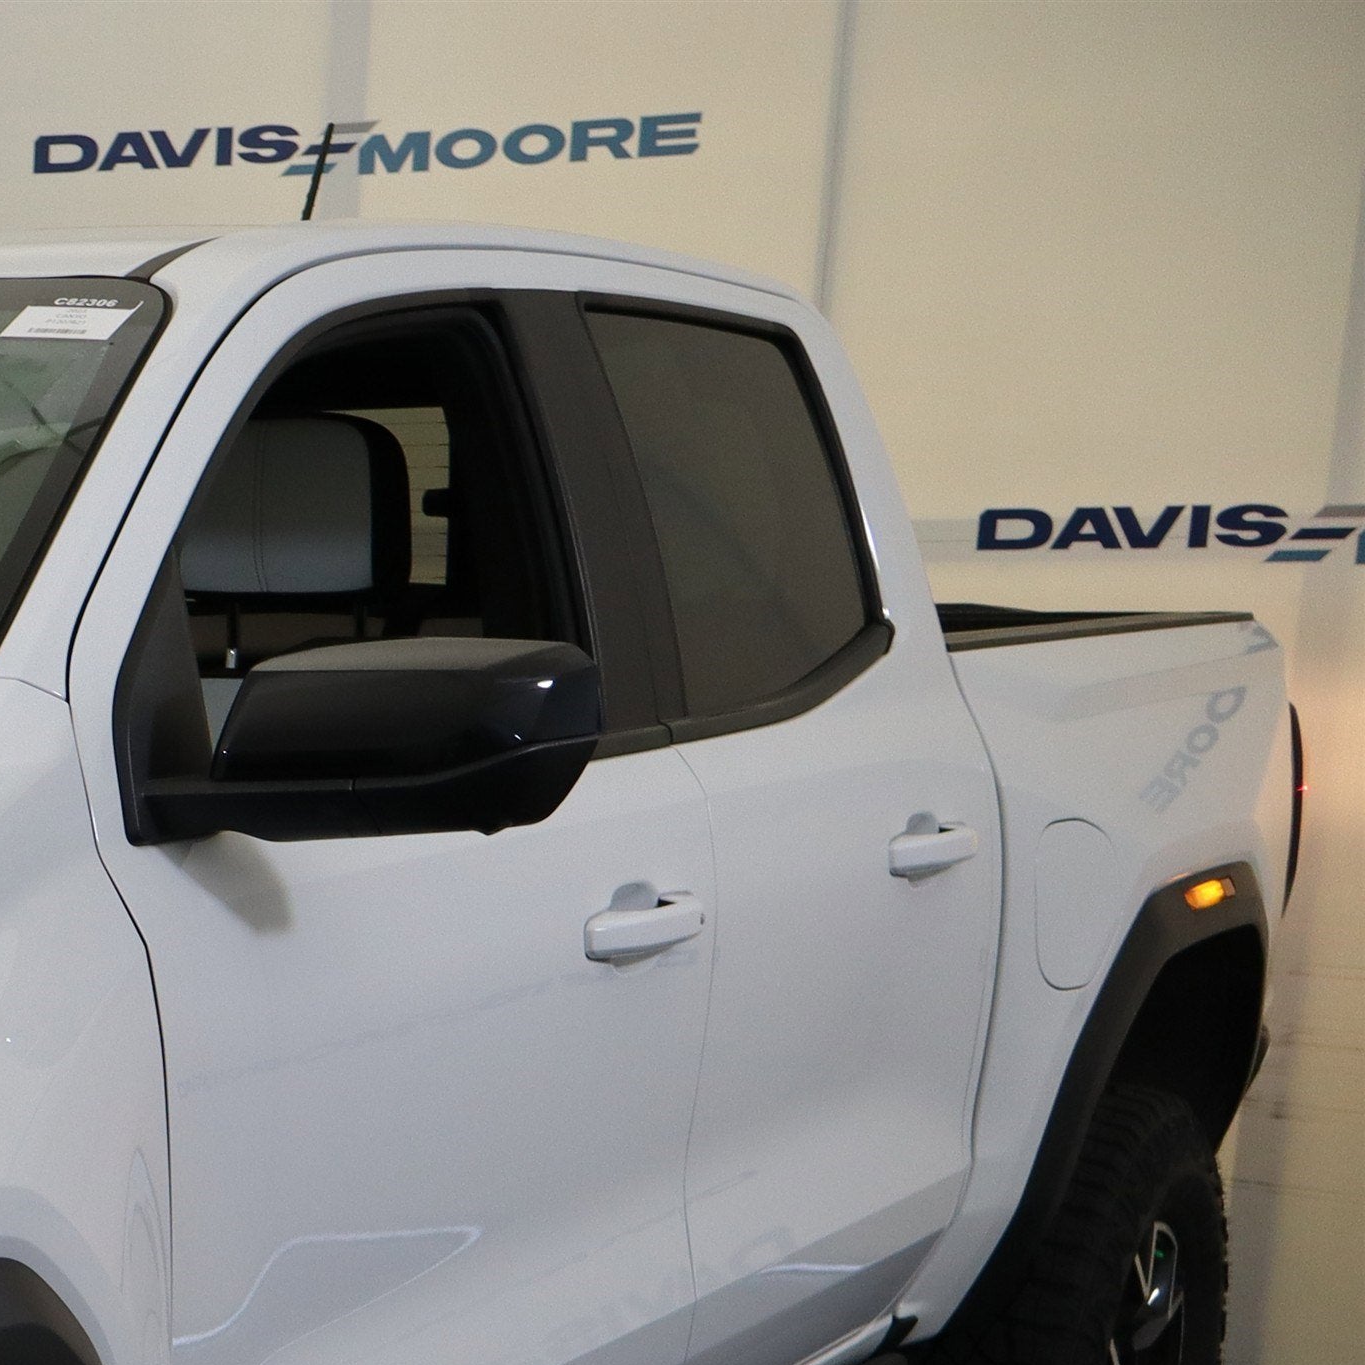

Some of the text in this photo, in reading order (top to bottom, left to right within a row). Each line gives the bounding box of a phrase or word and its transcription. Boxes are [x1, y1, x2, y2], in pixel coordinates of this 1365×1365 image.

[32, 112, 703, 176] DAVIS MOORE
[975, 503, 1290, 551] DAVIS
